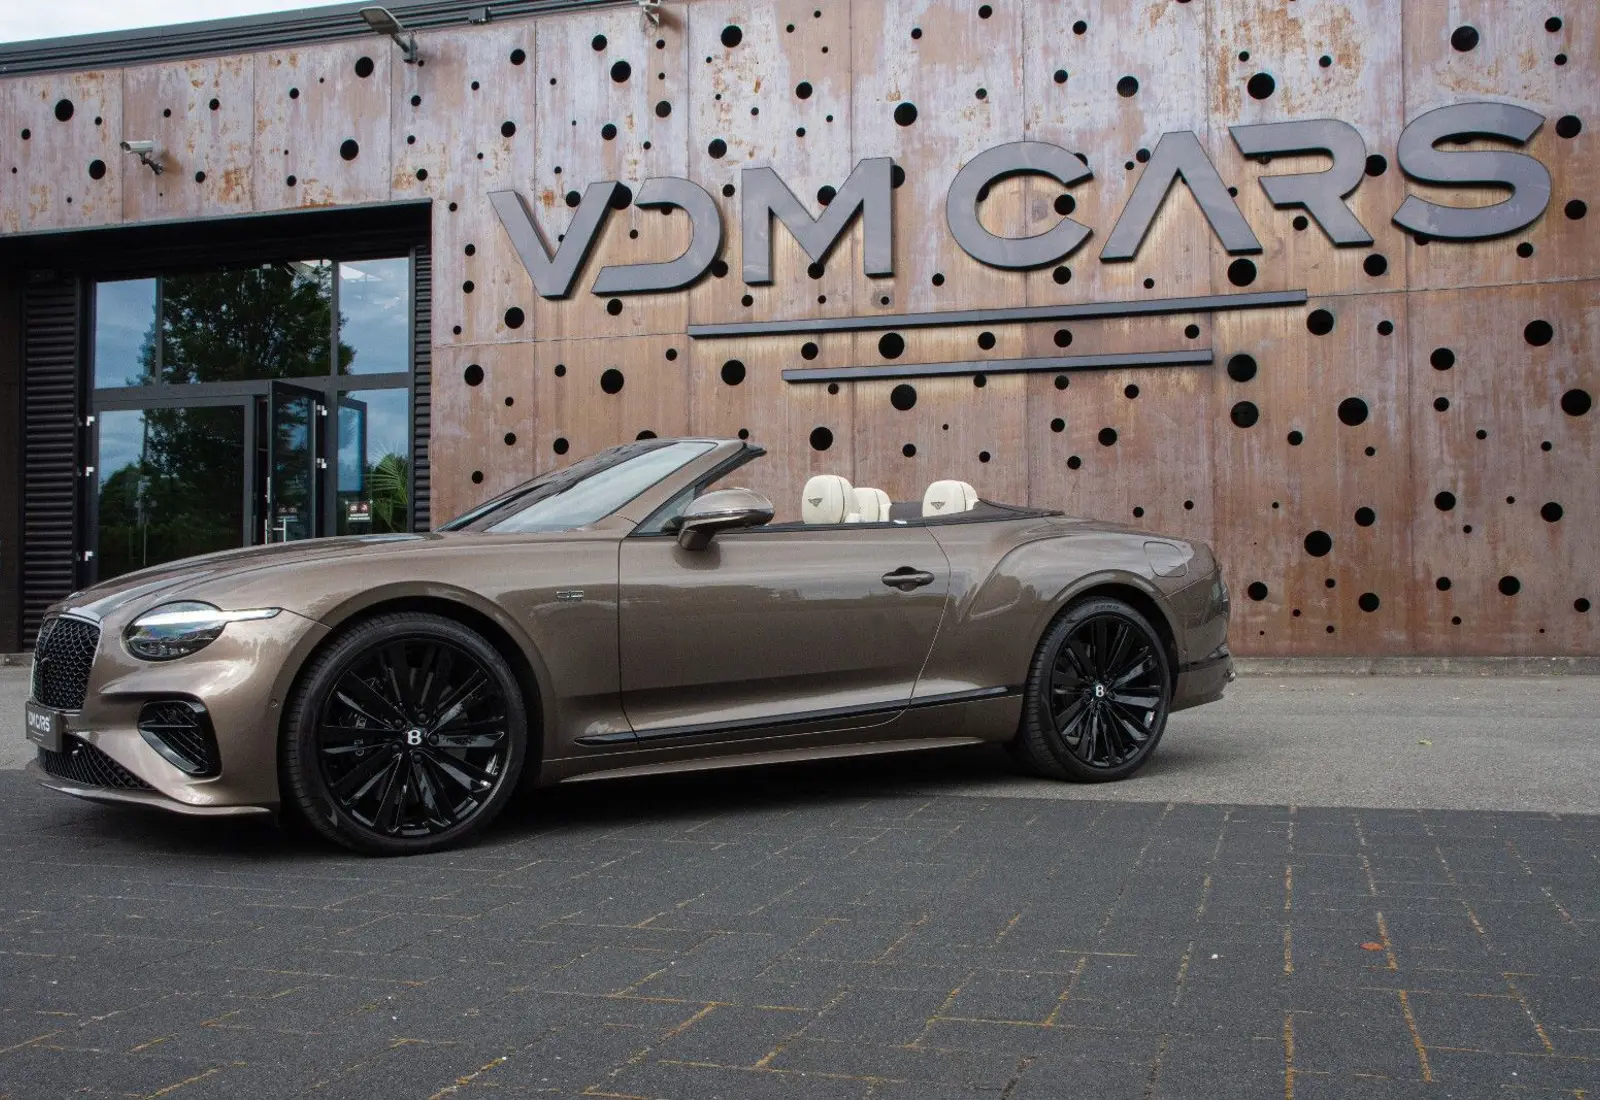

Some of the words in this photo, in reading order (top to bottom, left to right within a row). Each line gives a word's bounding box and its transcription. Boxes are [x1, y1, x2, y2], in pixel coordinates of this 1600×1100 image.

[490, 156, 895, 299] VDM
[946, 102, 1553, 269] CARS
[1095, 684, 1105, 697] B
[407, 729, 422, 746] B
